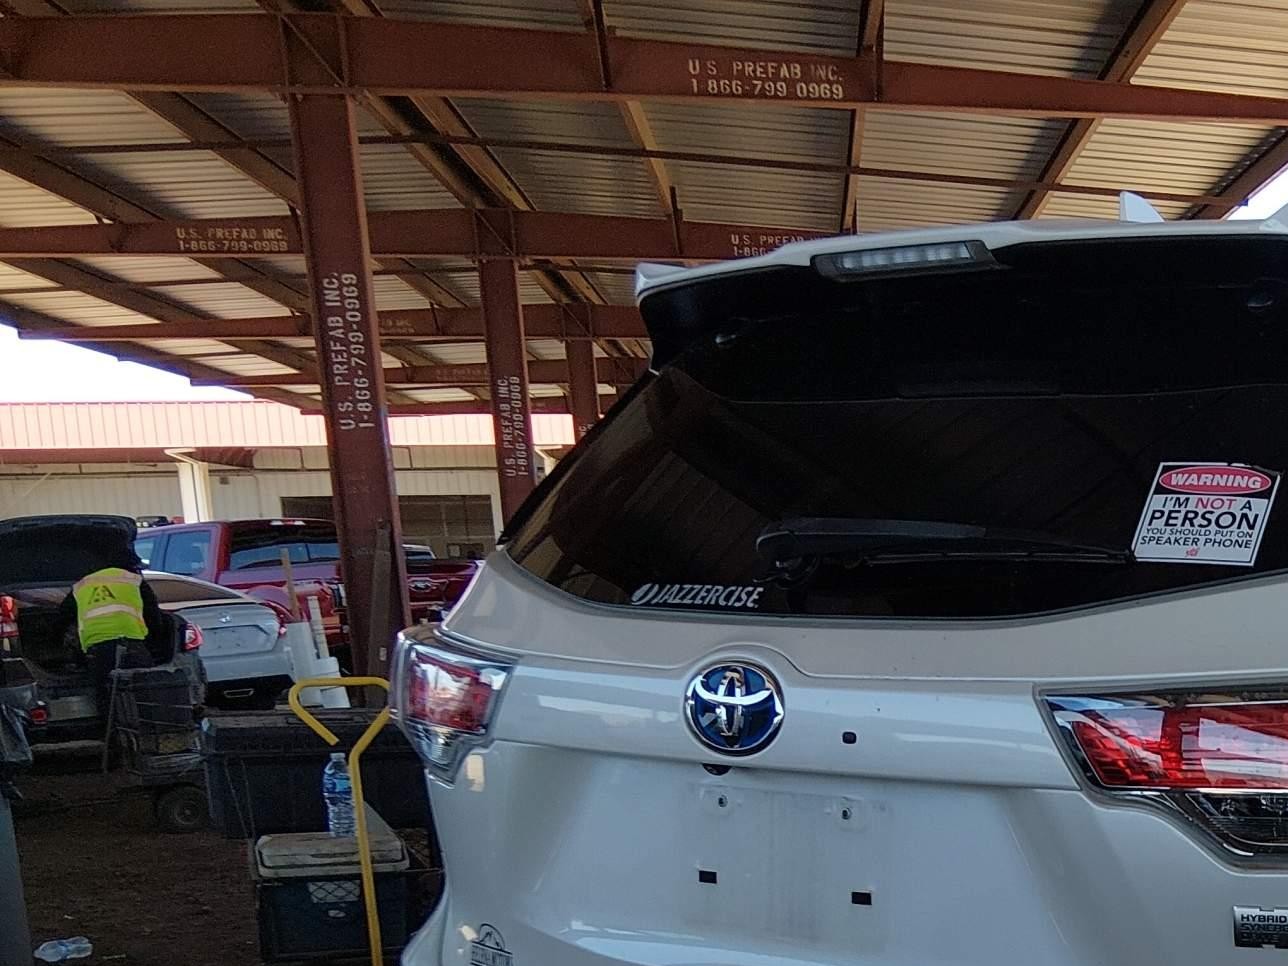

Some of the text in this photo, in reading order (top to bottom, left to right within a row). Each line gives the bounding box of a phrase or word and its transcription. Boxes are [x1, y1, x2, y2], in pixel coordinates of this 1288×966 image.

[732, 61, 801, 79] PREFAB
[810, 64, 844, 81] INC.
[207, 227, 257, 239] PREFAB
[322, 272, 356, 430] U.S. PREFAB INC.
[341, 273, 376, 428] 1-866-799-0969
[499, 403, 514, 448] PREFAB
[1169, 473, 1262, 489] WARNING
[1162, 496, 1253, 511] I'M NOT A
[1147, 509, 1260, 530] PERSON
[1145, 527, 1254, 539] YOU SHOULD PUT ON
[1140, 535, 1253, 549] SPEAKER PHONE
[1240, 914, 1287, 923] HYBRID
